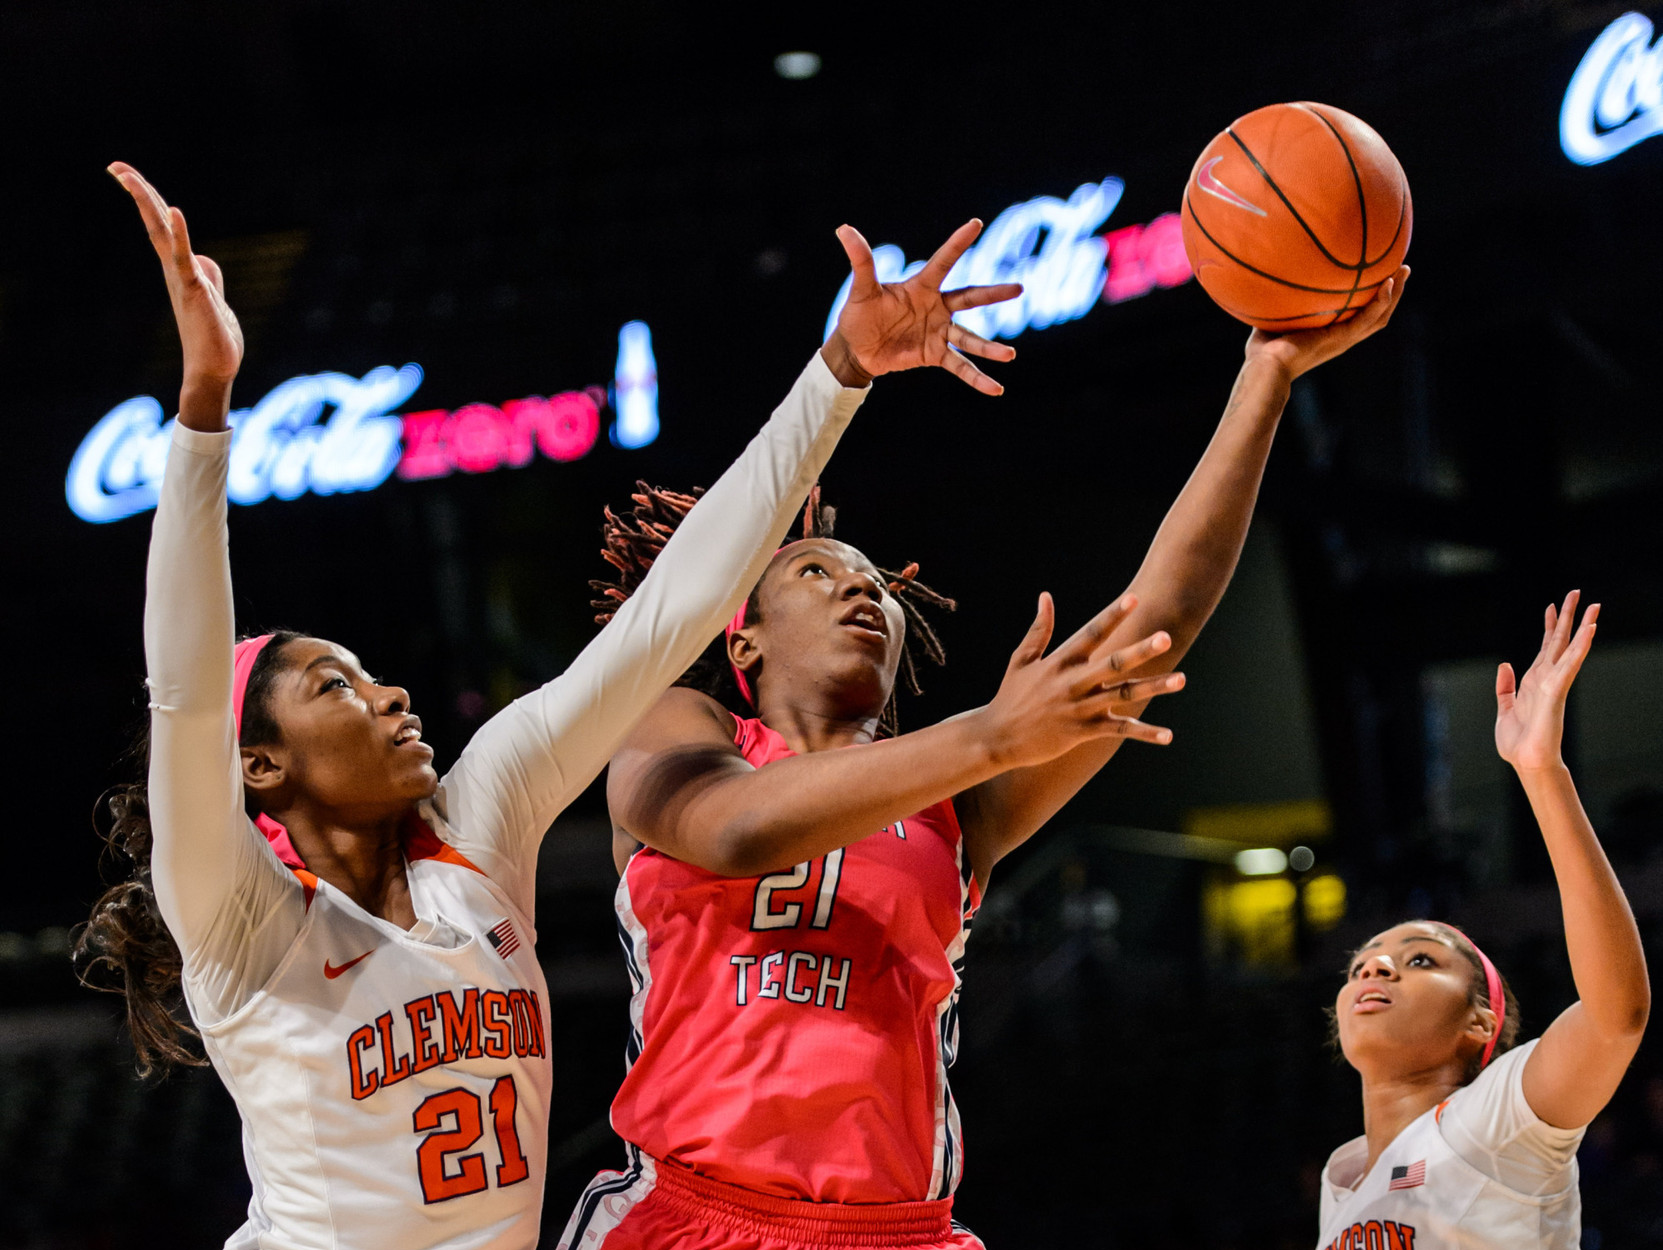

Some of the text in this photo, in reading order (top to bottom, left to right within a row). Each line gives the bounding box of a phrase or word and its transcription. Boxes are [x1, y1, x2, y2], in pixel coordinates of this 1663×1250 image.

[750, 847, 846, 932] 21
[730, 949, 852, 1010] TECH
[346, 987, 546, 1101] CLEMSON
[412, 1073, 530, 1205] 21
